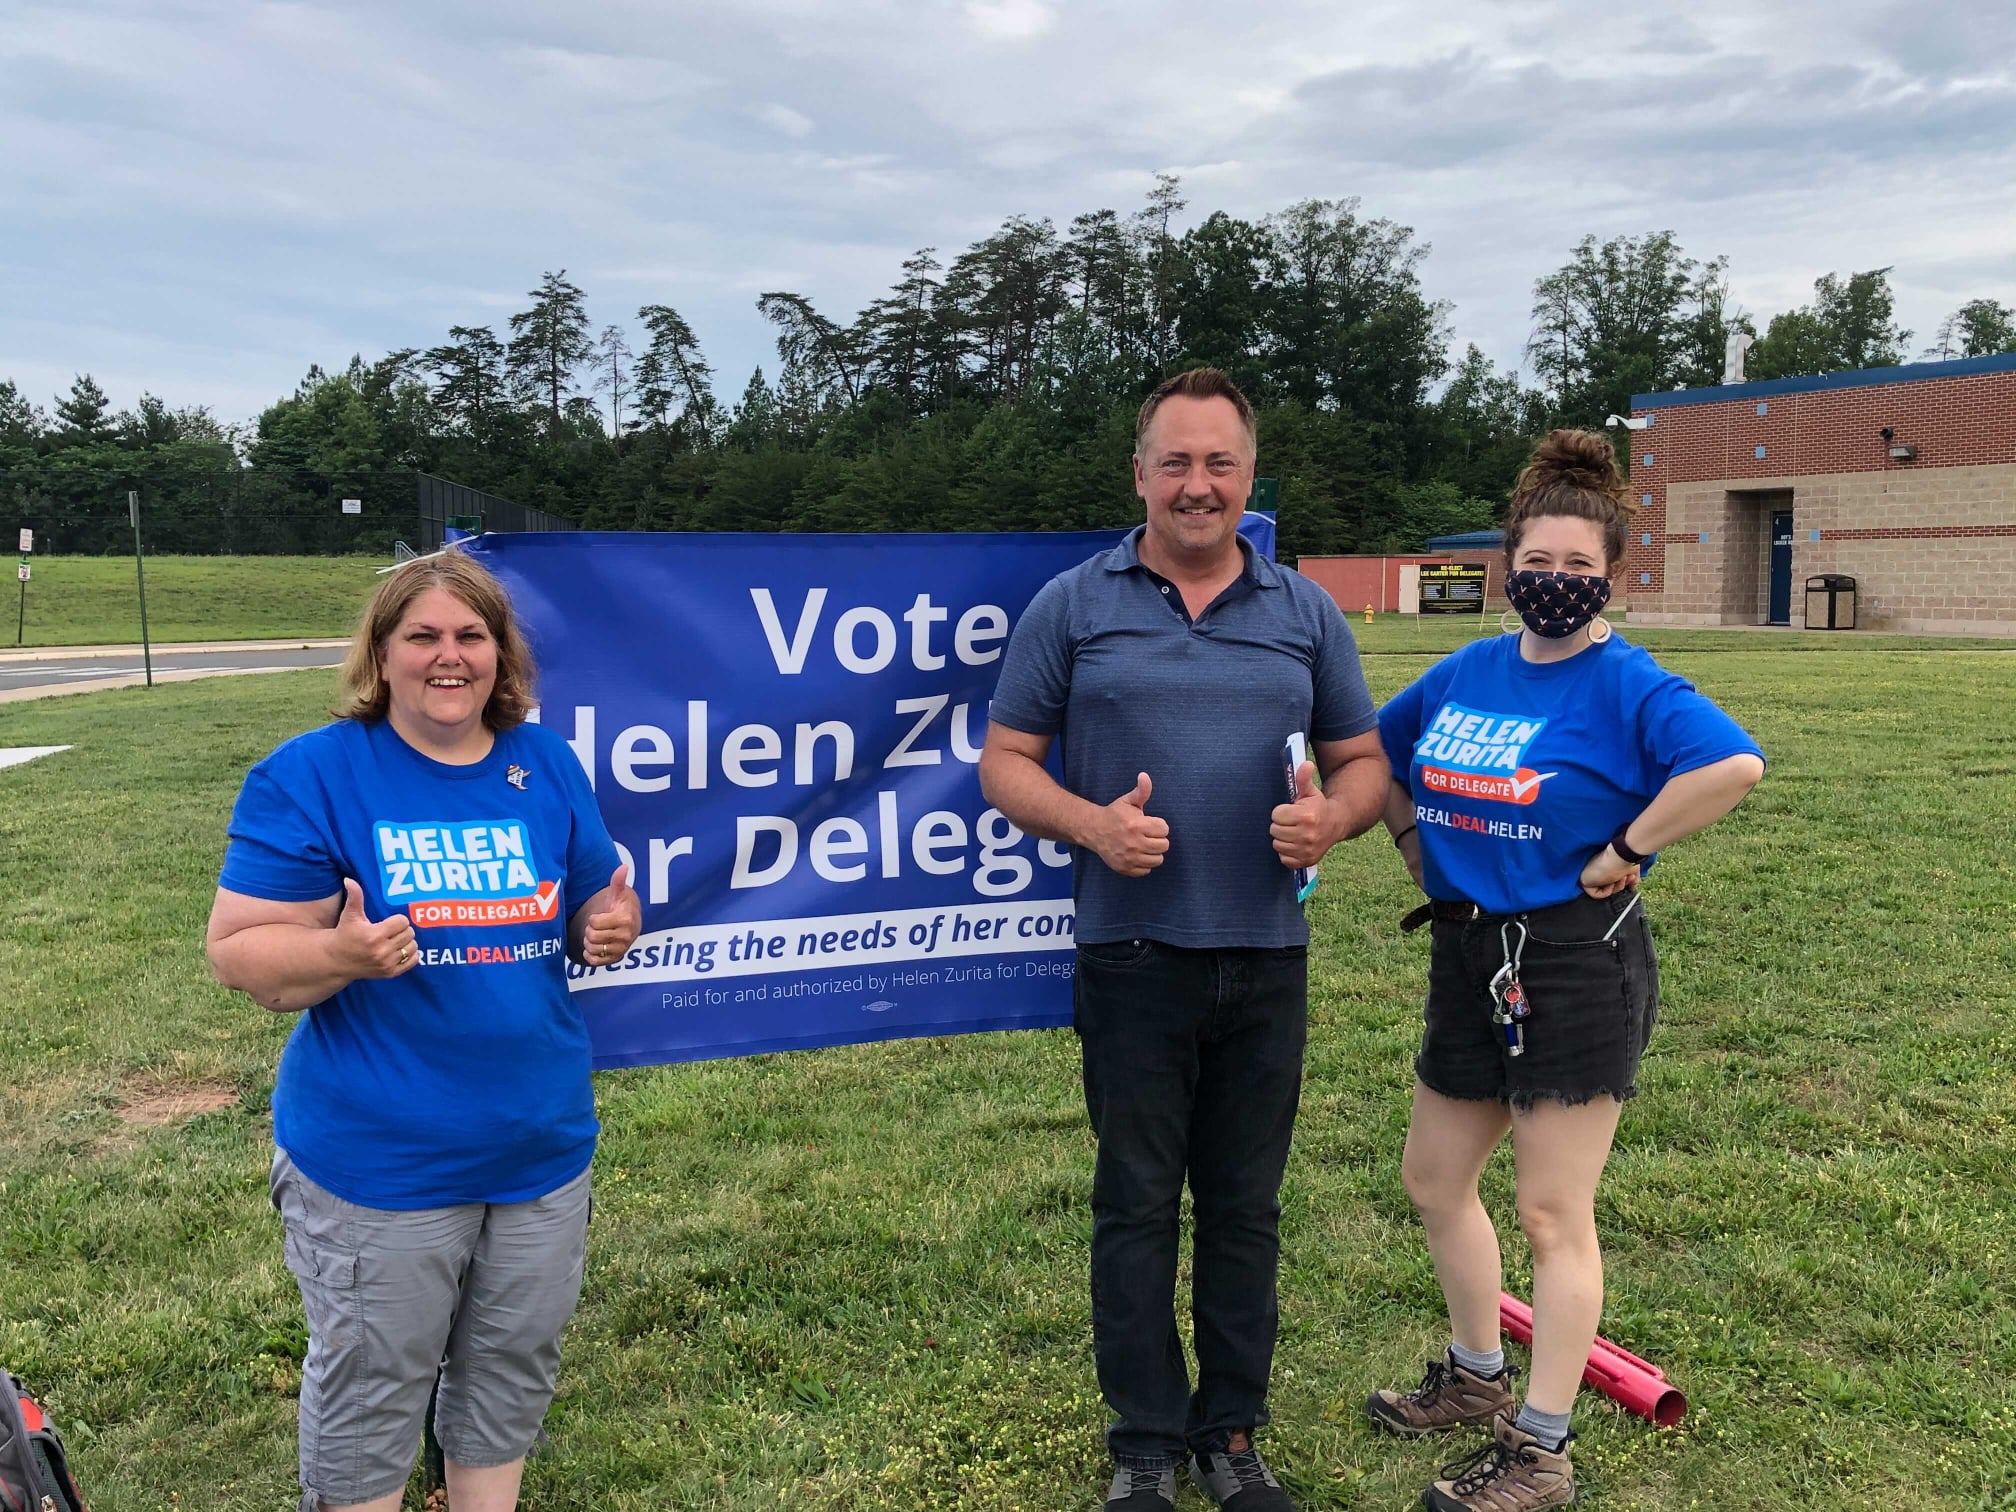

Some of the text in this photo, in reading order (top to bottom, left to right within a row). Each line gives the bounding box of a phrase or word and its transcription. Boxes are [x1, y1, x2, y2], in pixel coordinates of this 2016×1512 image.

[750, 588, 1009, 675] Vote
[1432, 706, 1541, 745] HELEN
[1417, 732, 1522, 770] ZURITA
[1424, 771, 1511, 797] FOR DELEGATE
[378, 825, 525, 862] HELEN
[386, 858, 537, 897] ZURITA
[415, 902, 537, 923] FOR DELEGATE
[728, 930, 786, 962] the
[797, 919, 897, 956] needs
[908, 914, 945, 952] of
[951, 913, 1008, 943] her
[662, 990, 699, 1008] Paid
[704, 988, 729, 1005] for
[735, 985, 767, 1002] and
[772, 976, 864, 999] authorized
[869, 974, 887, 993] by
[893, 970, 940, 987] Helen
[945, 965, 993, 983] Zurita
[997, 962, 1020, 979] for
